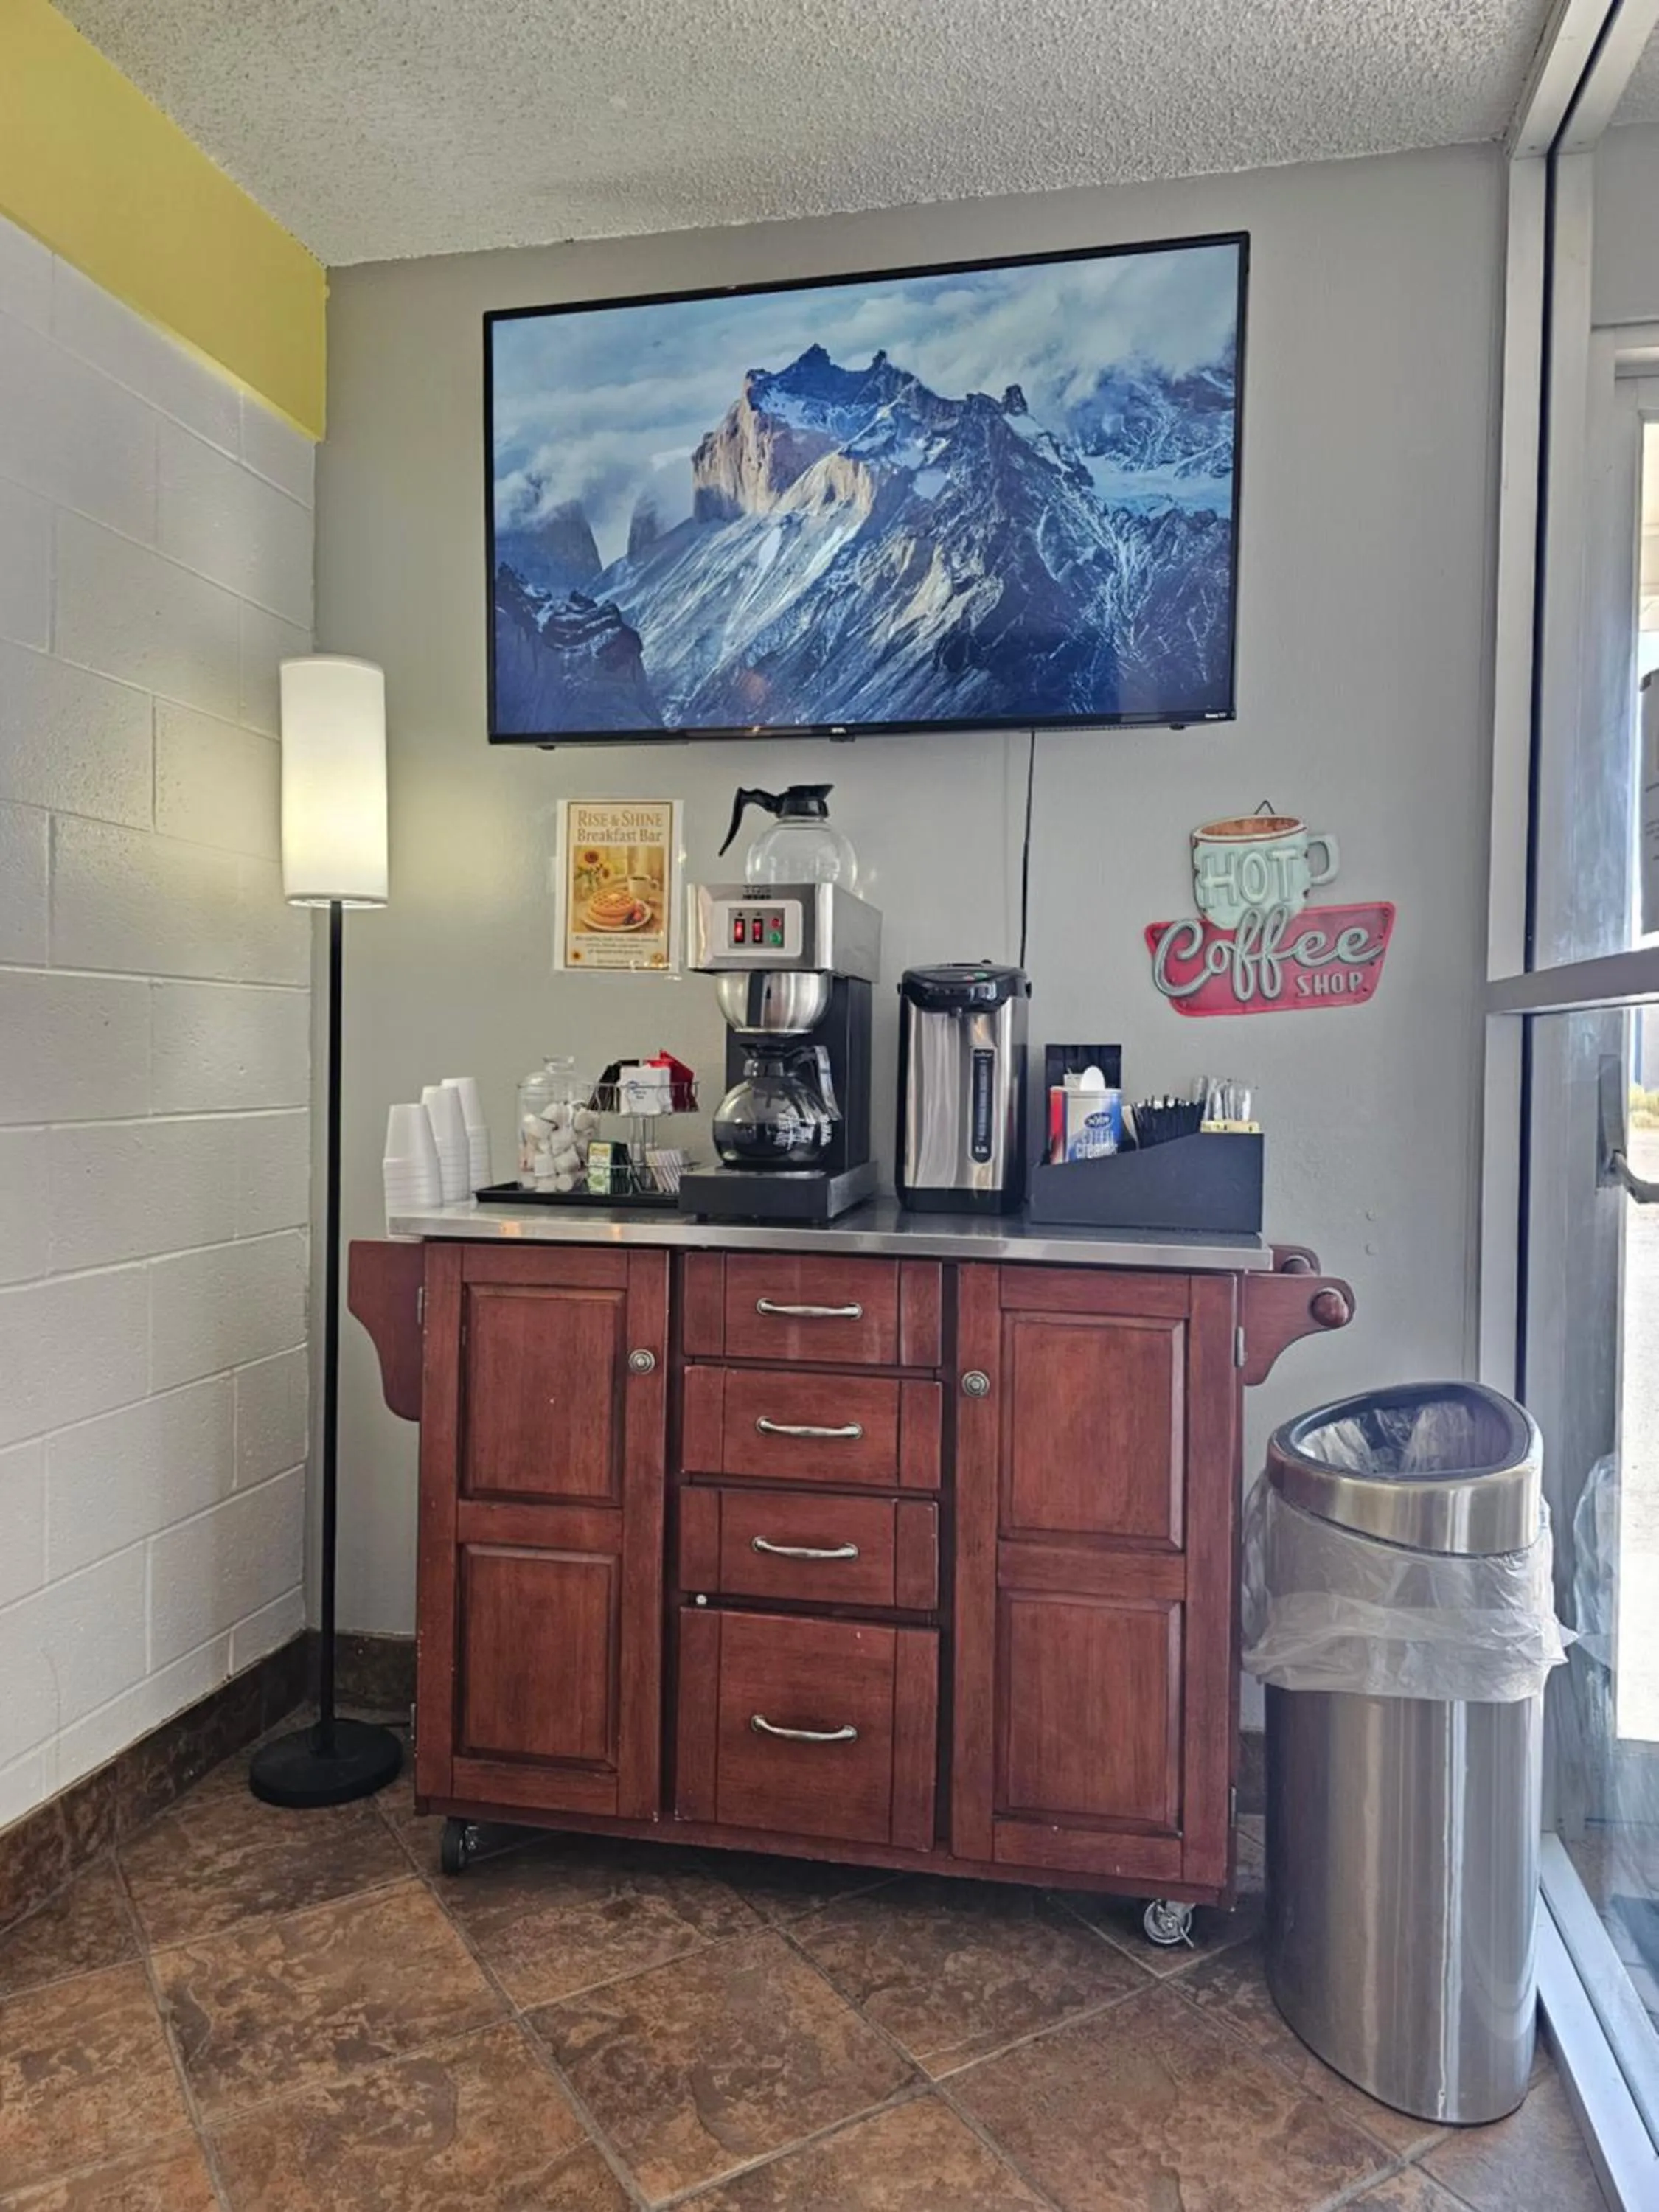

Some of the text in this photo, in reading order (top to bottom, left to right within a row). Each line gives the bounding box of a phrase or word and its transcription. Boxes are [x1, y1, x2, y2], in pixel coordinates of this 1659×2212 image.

[577, 809, 664, 827] RISE & SHINE
[577, 828, 663, 842] Breakfast Bar
[1201, 848, 1299, 907] HOT
[1152, 905, 1385, 1001] Coffee
[1295, 971, 1364, 998] SHOP
